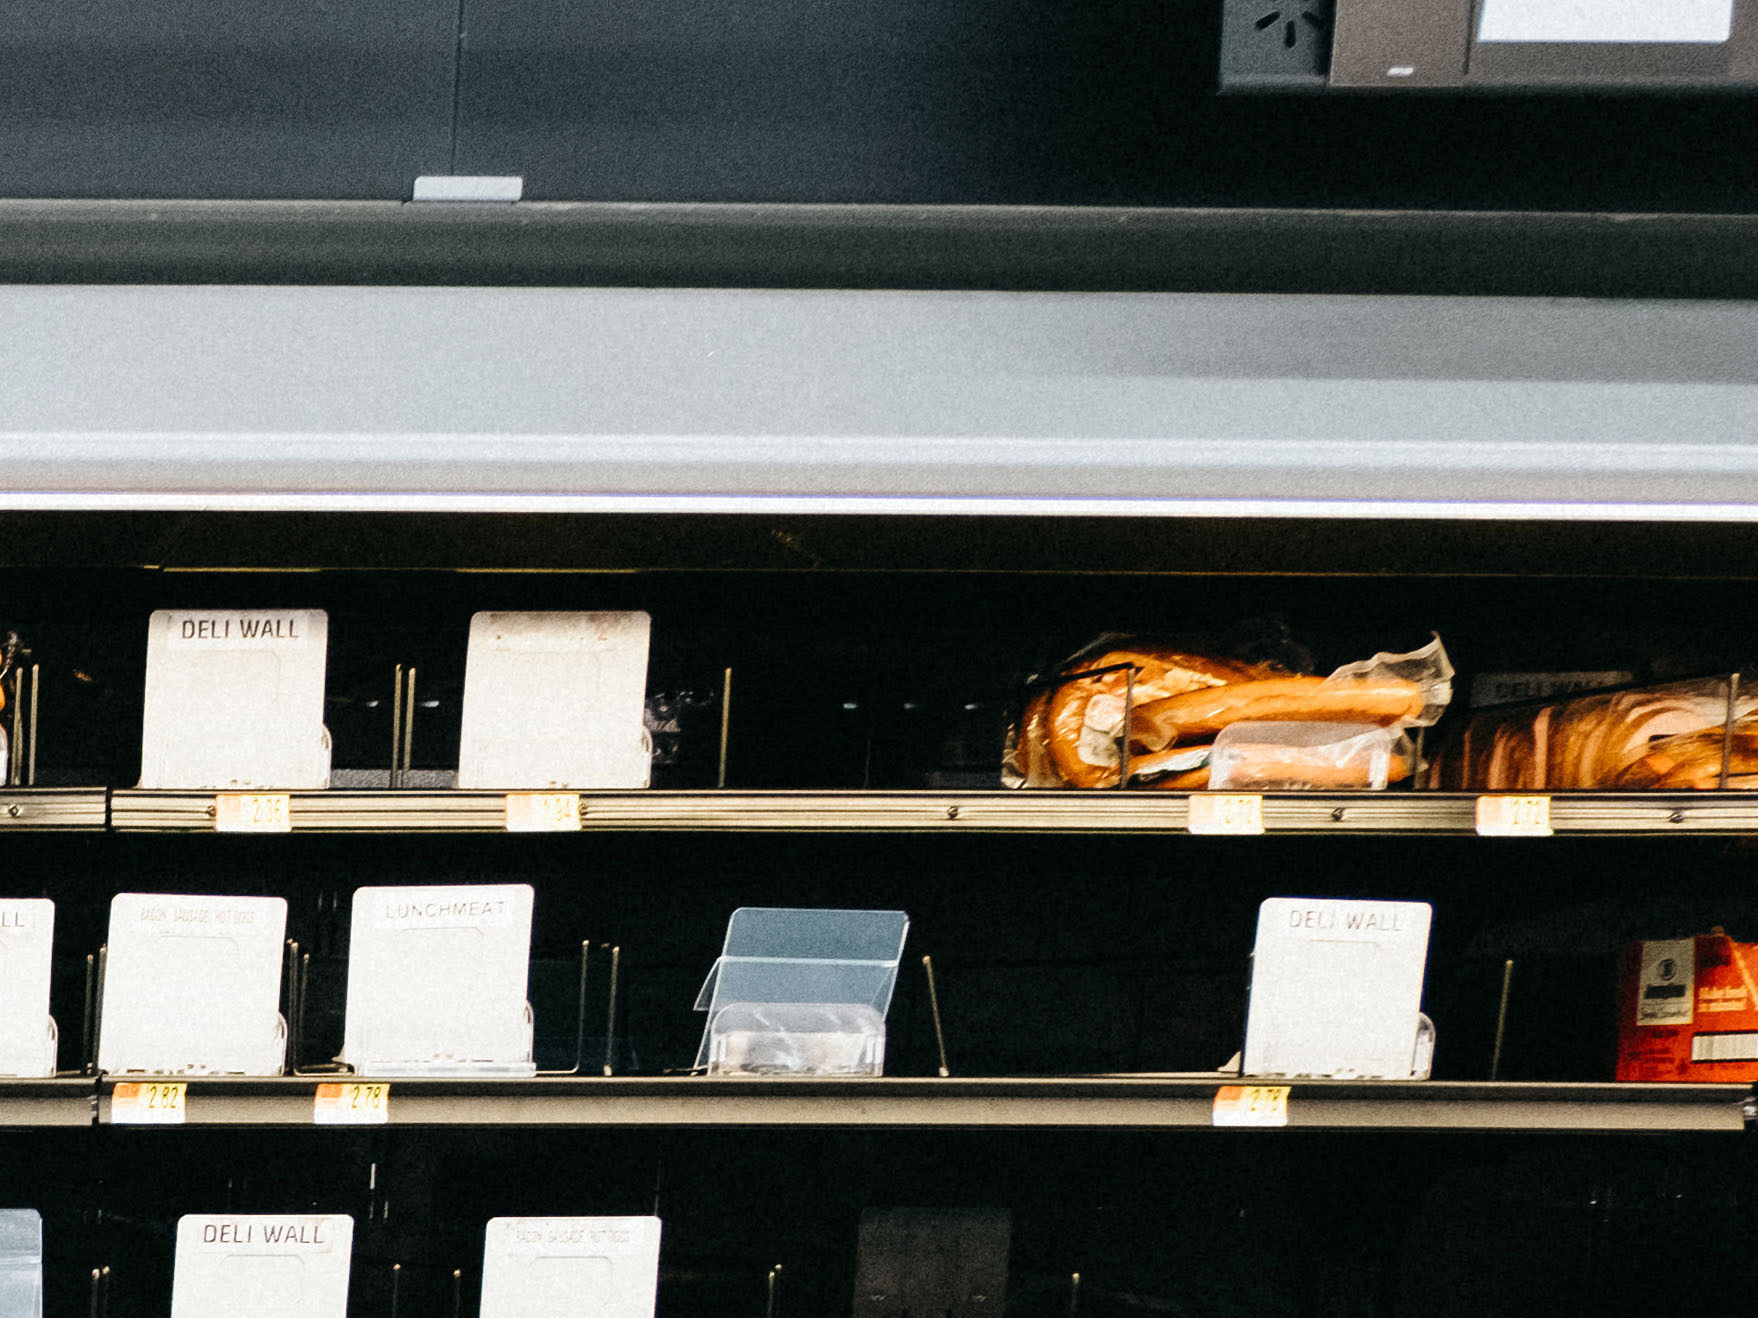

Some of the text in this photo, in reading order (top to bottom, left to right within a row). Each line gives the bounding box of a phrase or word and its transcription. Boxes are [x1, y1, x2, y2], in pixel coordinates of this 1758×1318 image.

[181, 618, 299, 640] DELI WALL
[202, 1223, 325, 1245] DELI WALL
